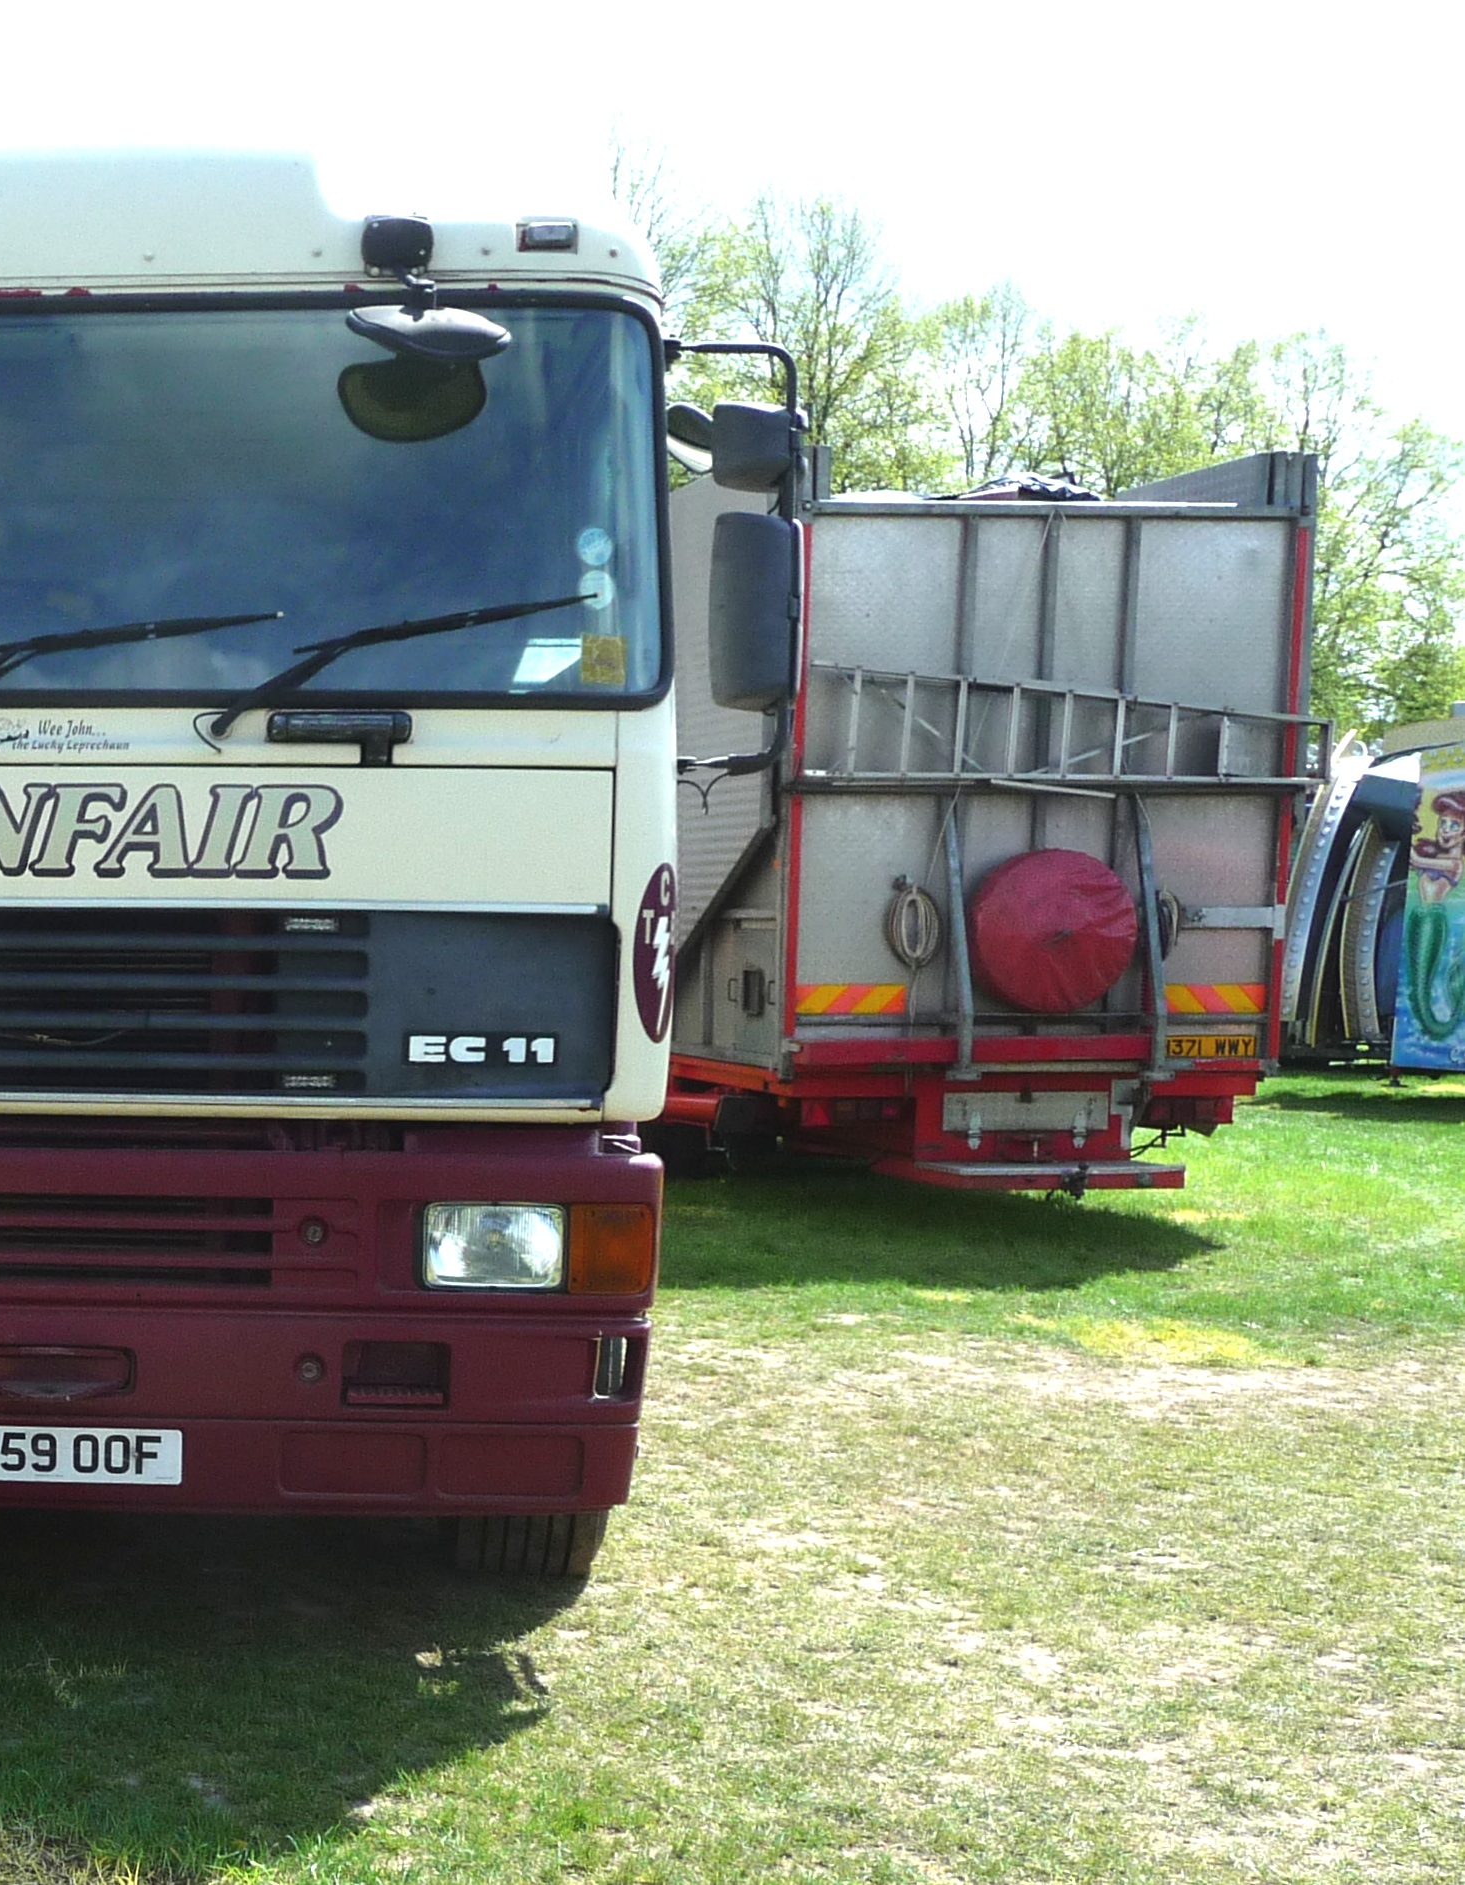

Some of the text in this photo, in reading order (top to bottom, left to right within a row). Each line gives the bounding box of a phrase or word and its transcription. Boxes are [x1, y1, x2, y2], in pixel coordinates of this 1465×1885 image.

[38, 719, 62, 735] Wee
[32, 740, 65, 754] Lucky
[66, 739, 130, 754] Leprechaun
[660, 870, 671, 906] C
[642, 908, 656, 944] T
[408, 1035, 555, 1063] EC 11
[1215, 1038, 1253, 1056] WWY
